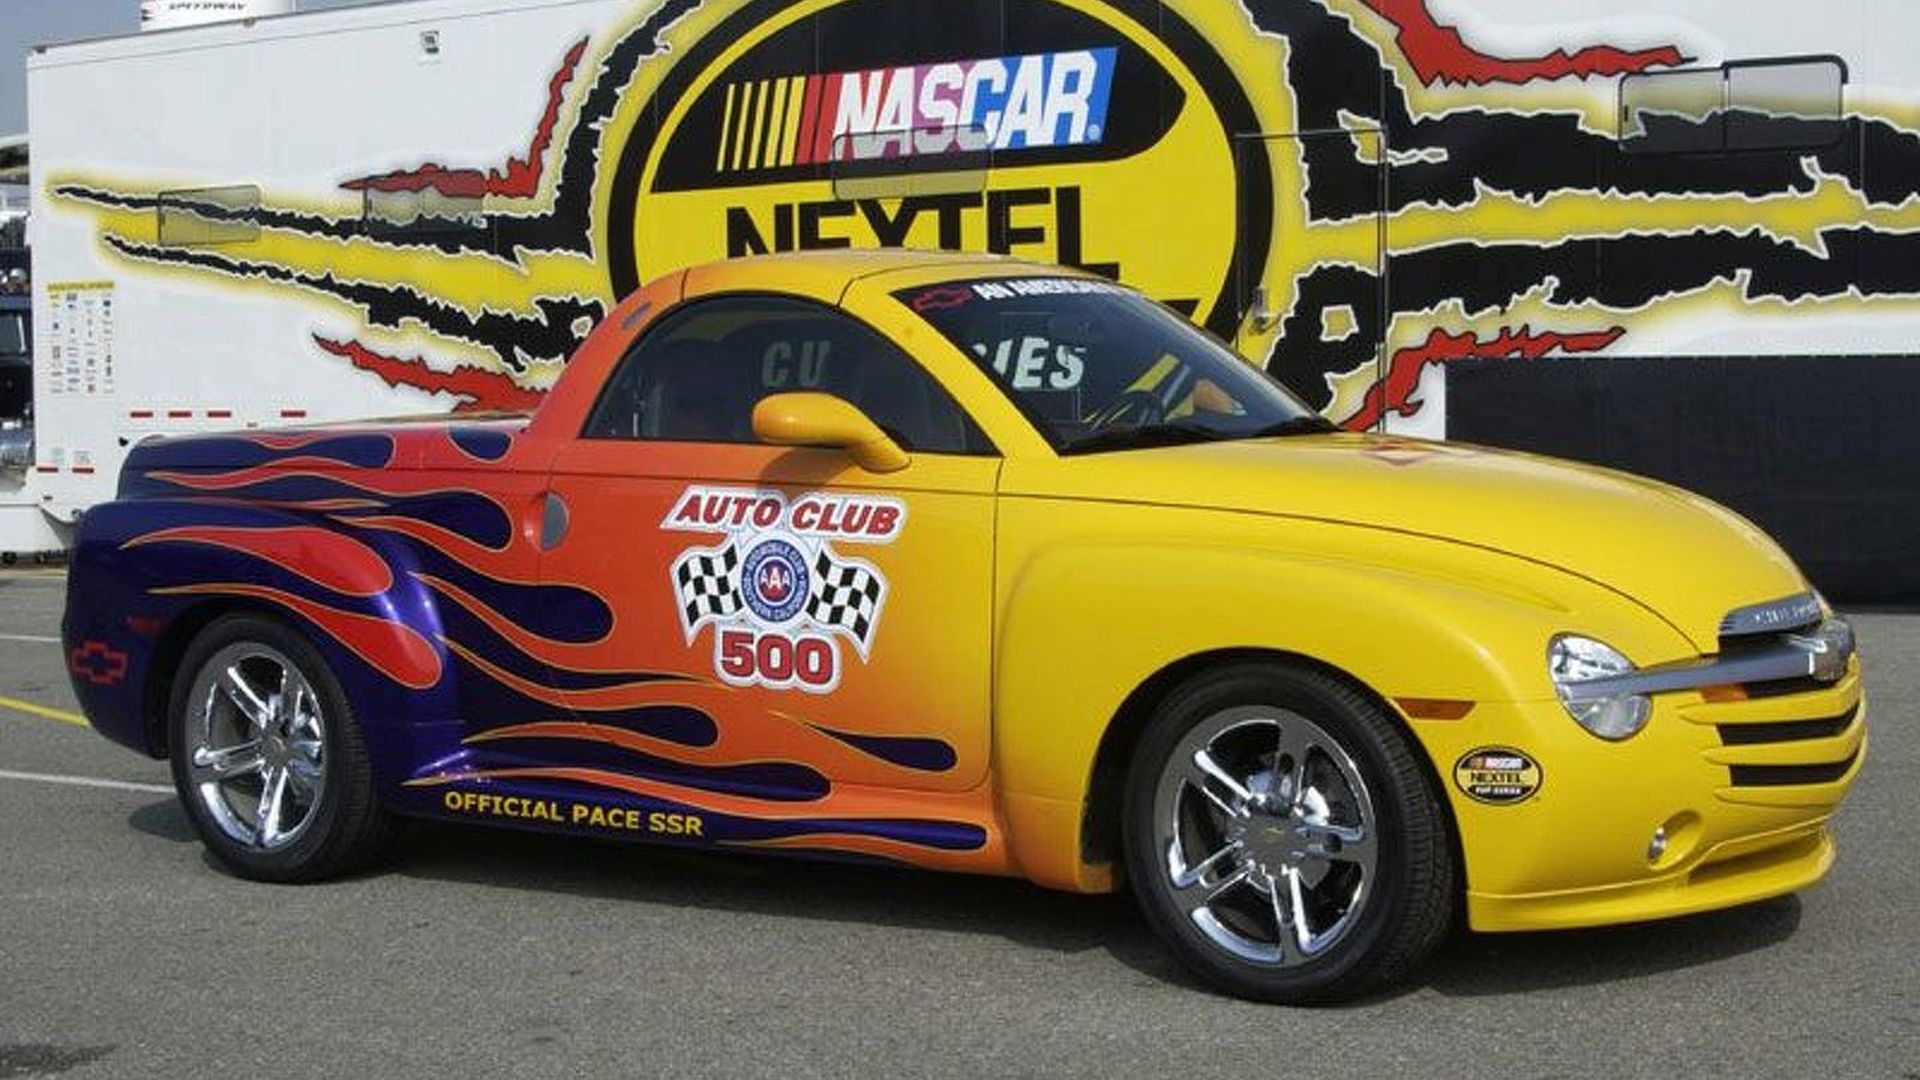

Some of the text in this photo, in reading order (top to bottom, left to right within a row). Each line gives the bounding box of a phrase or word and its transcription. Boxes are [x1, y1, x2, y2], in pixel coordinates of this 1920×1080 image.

[830, 50, 1098, 162] NASCAR
[971, 336, 1088, 390] IES
[675, 494, 901, 536] AUTO CLUB
[760, 567, 791, 590] AAA
[721, 630, 834, 685] 500
[1470, 772, 1522, 784] NEXTEL
[445, 791, 703, 837] OFFICIAL PACE SSR
